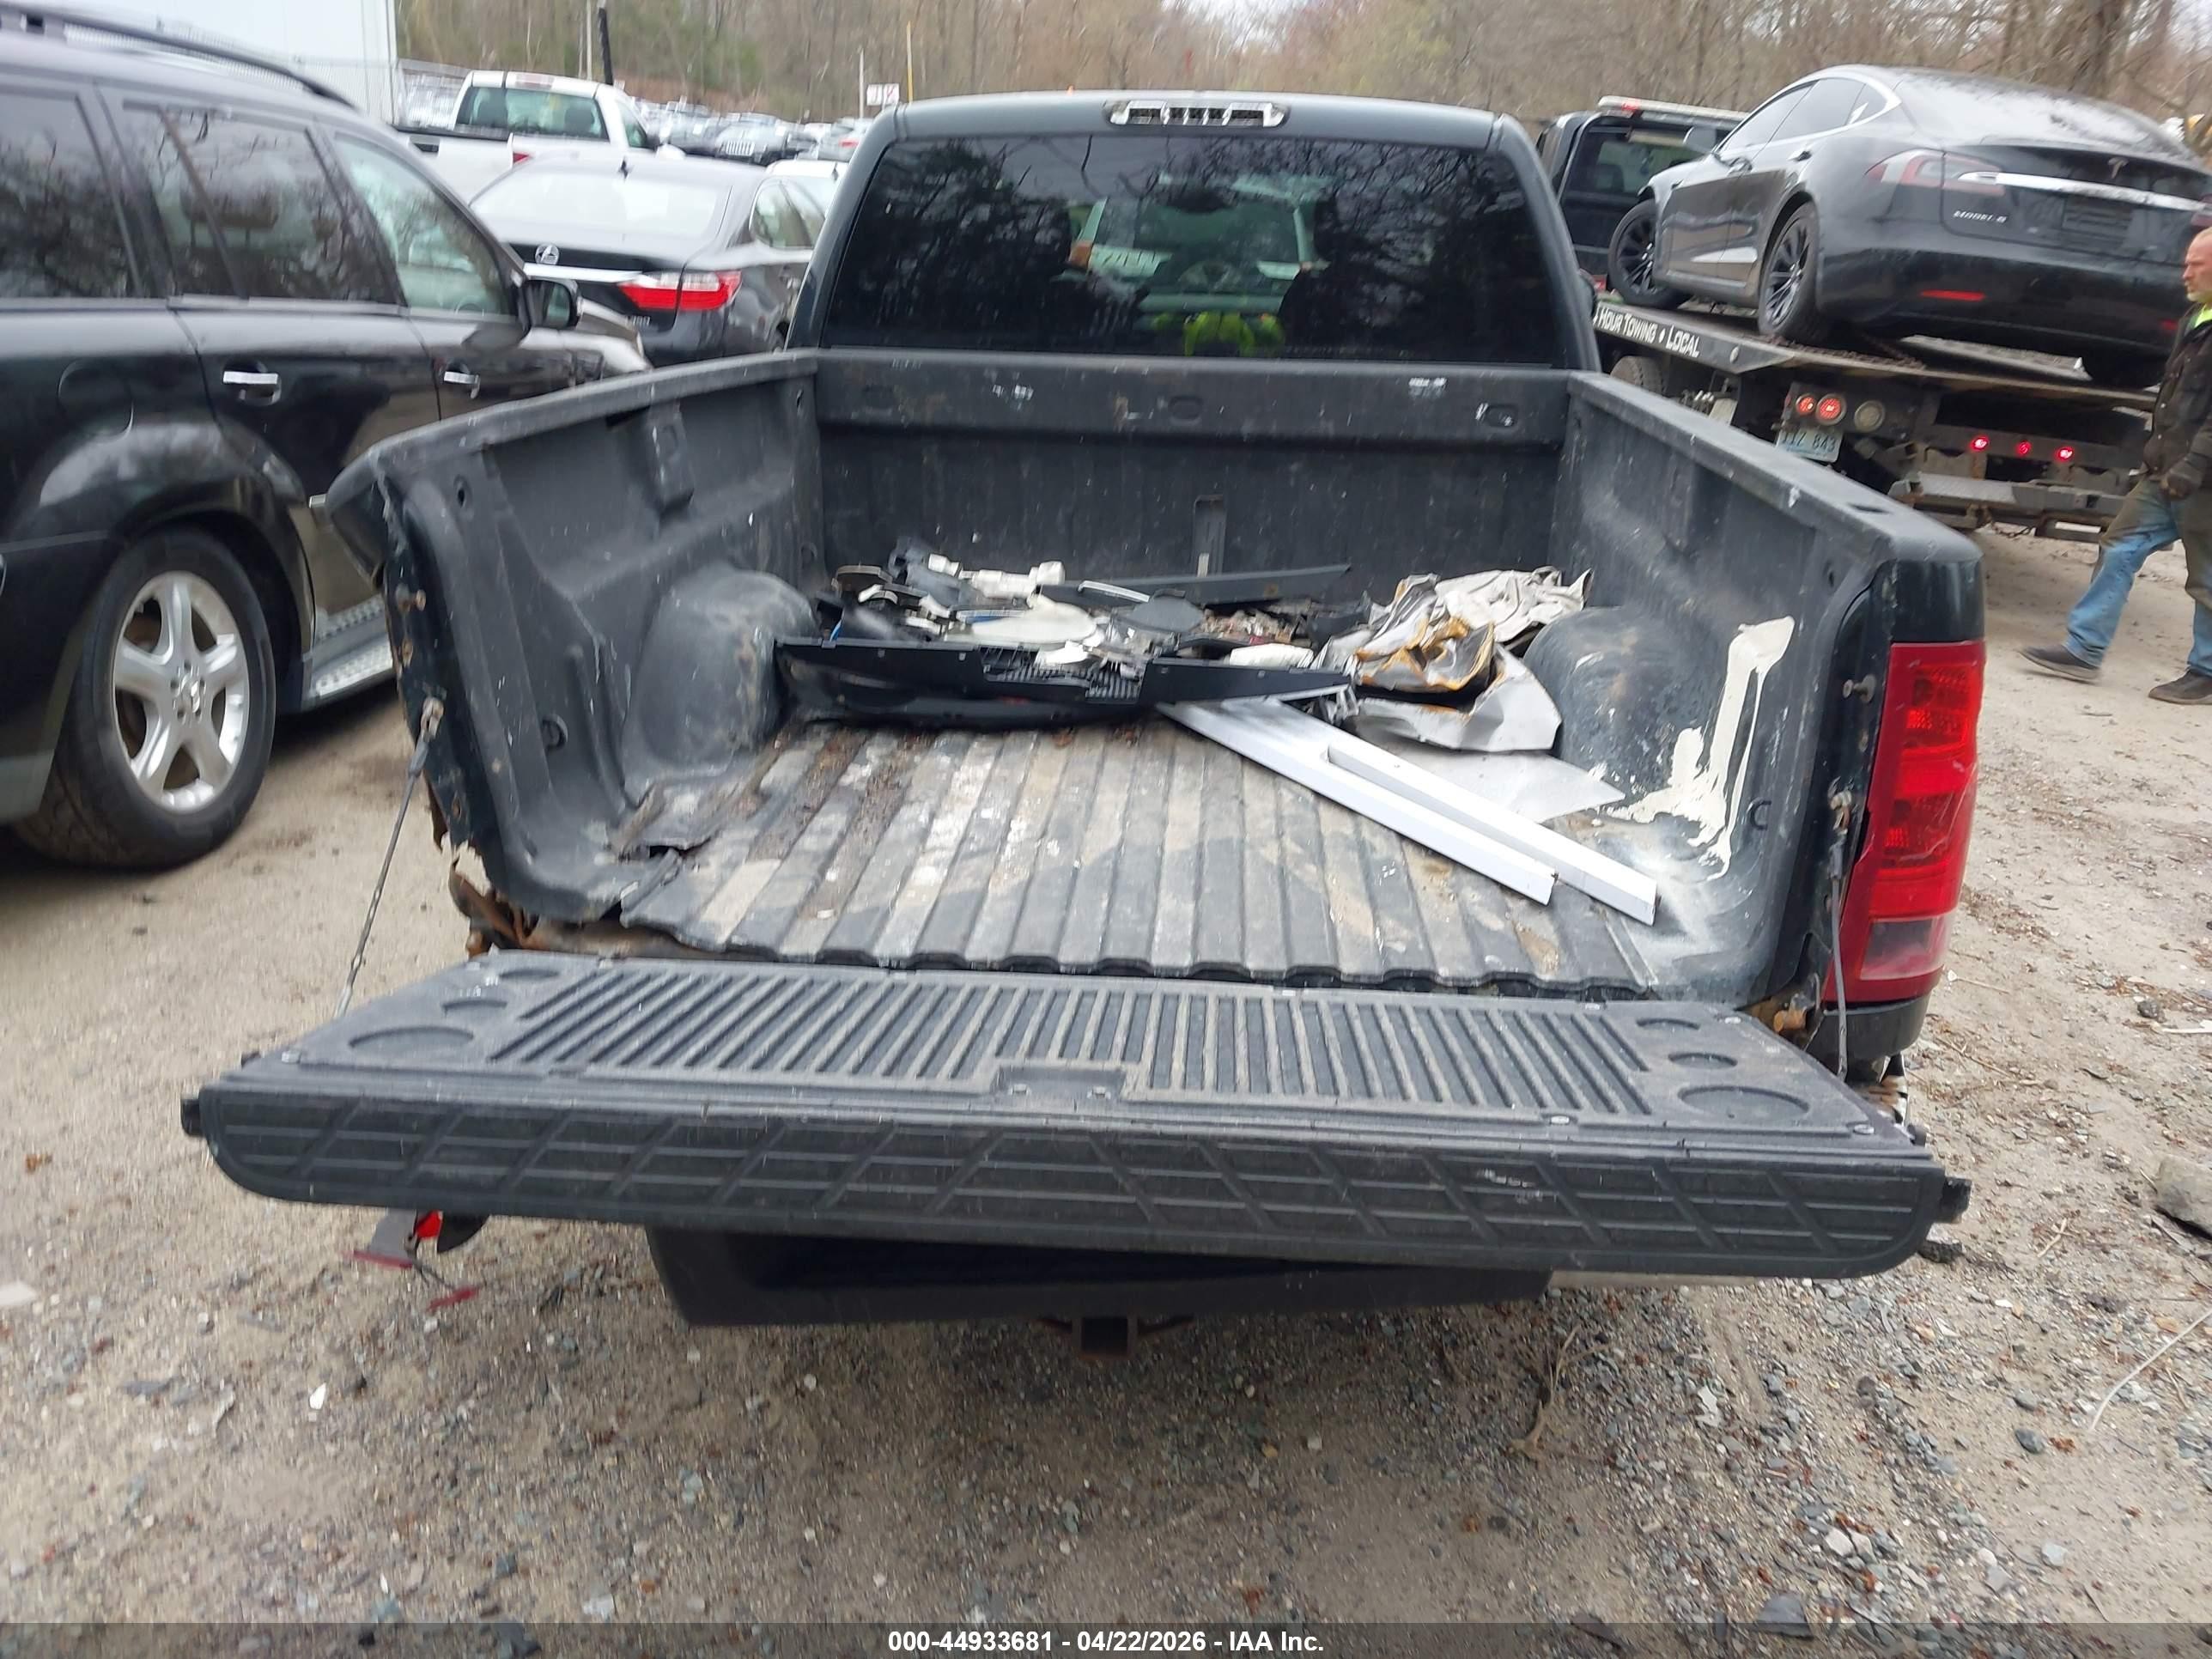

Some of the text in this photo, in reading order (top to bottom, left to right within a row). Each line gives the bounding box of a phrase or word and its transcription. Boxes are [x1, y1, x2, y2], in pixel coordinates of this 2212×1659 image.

[1598, 307, 1624, 334] HOUR
[1623, 313, 1658, 343] TOWING
[1666, 325, 1700, 358] LOCAL
